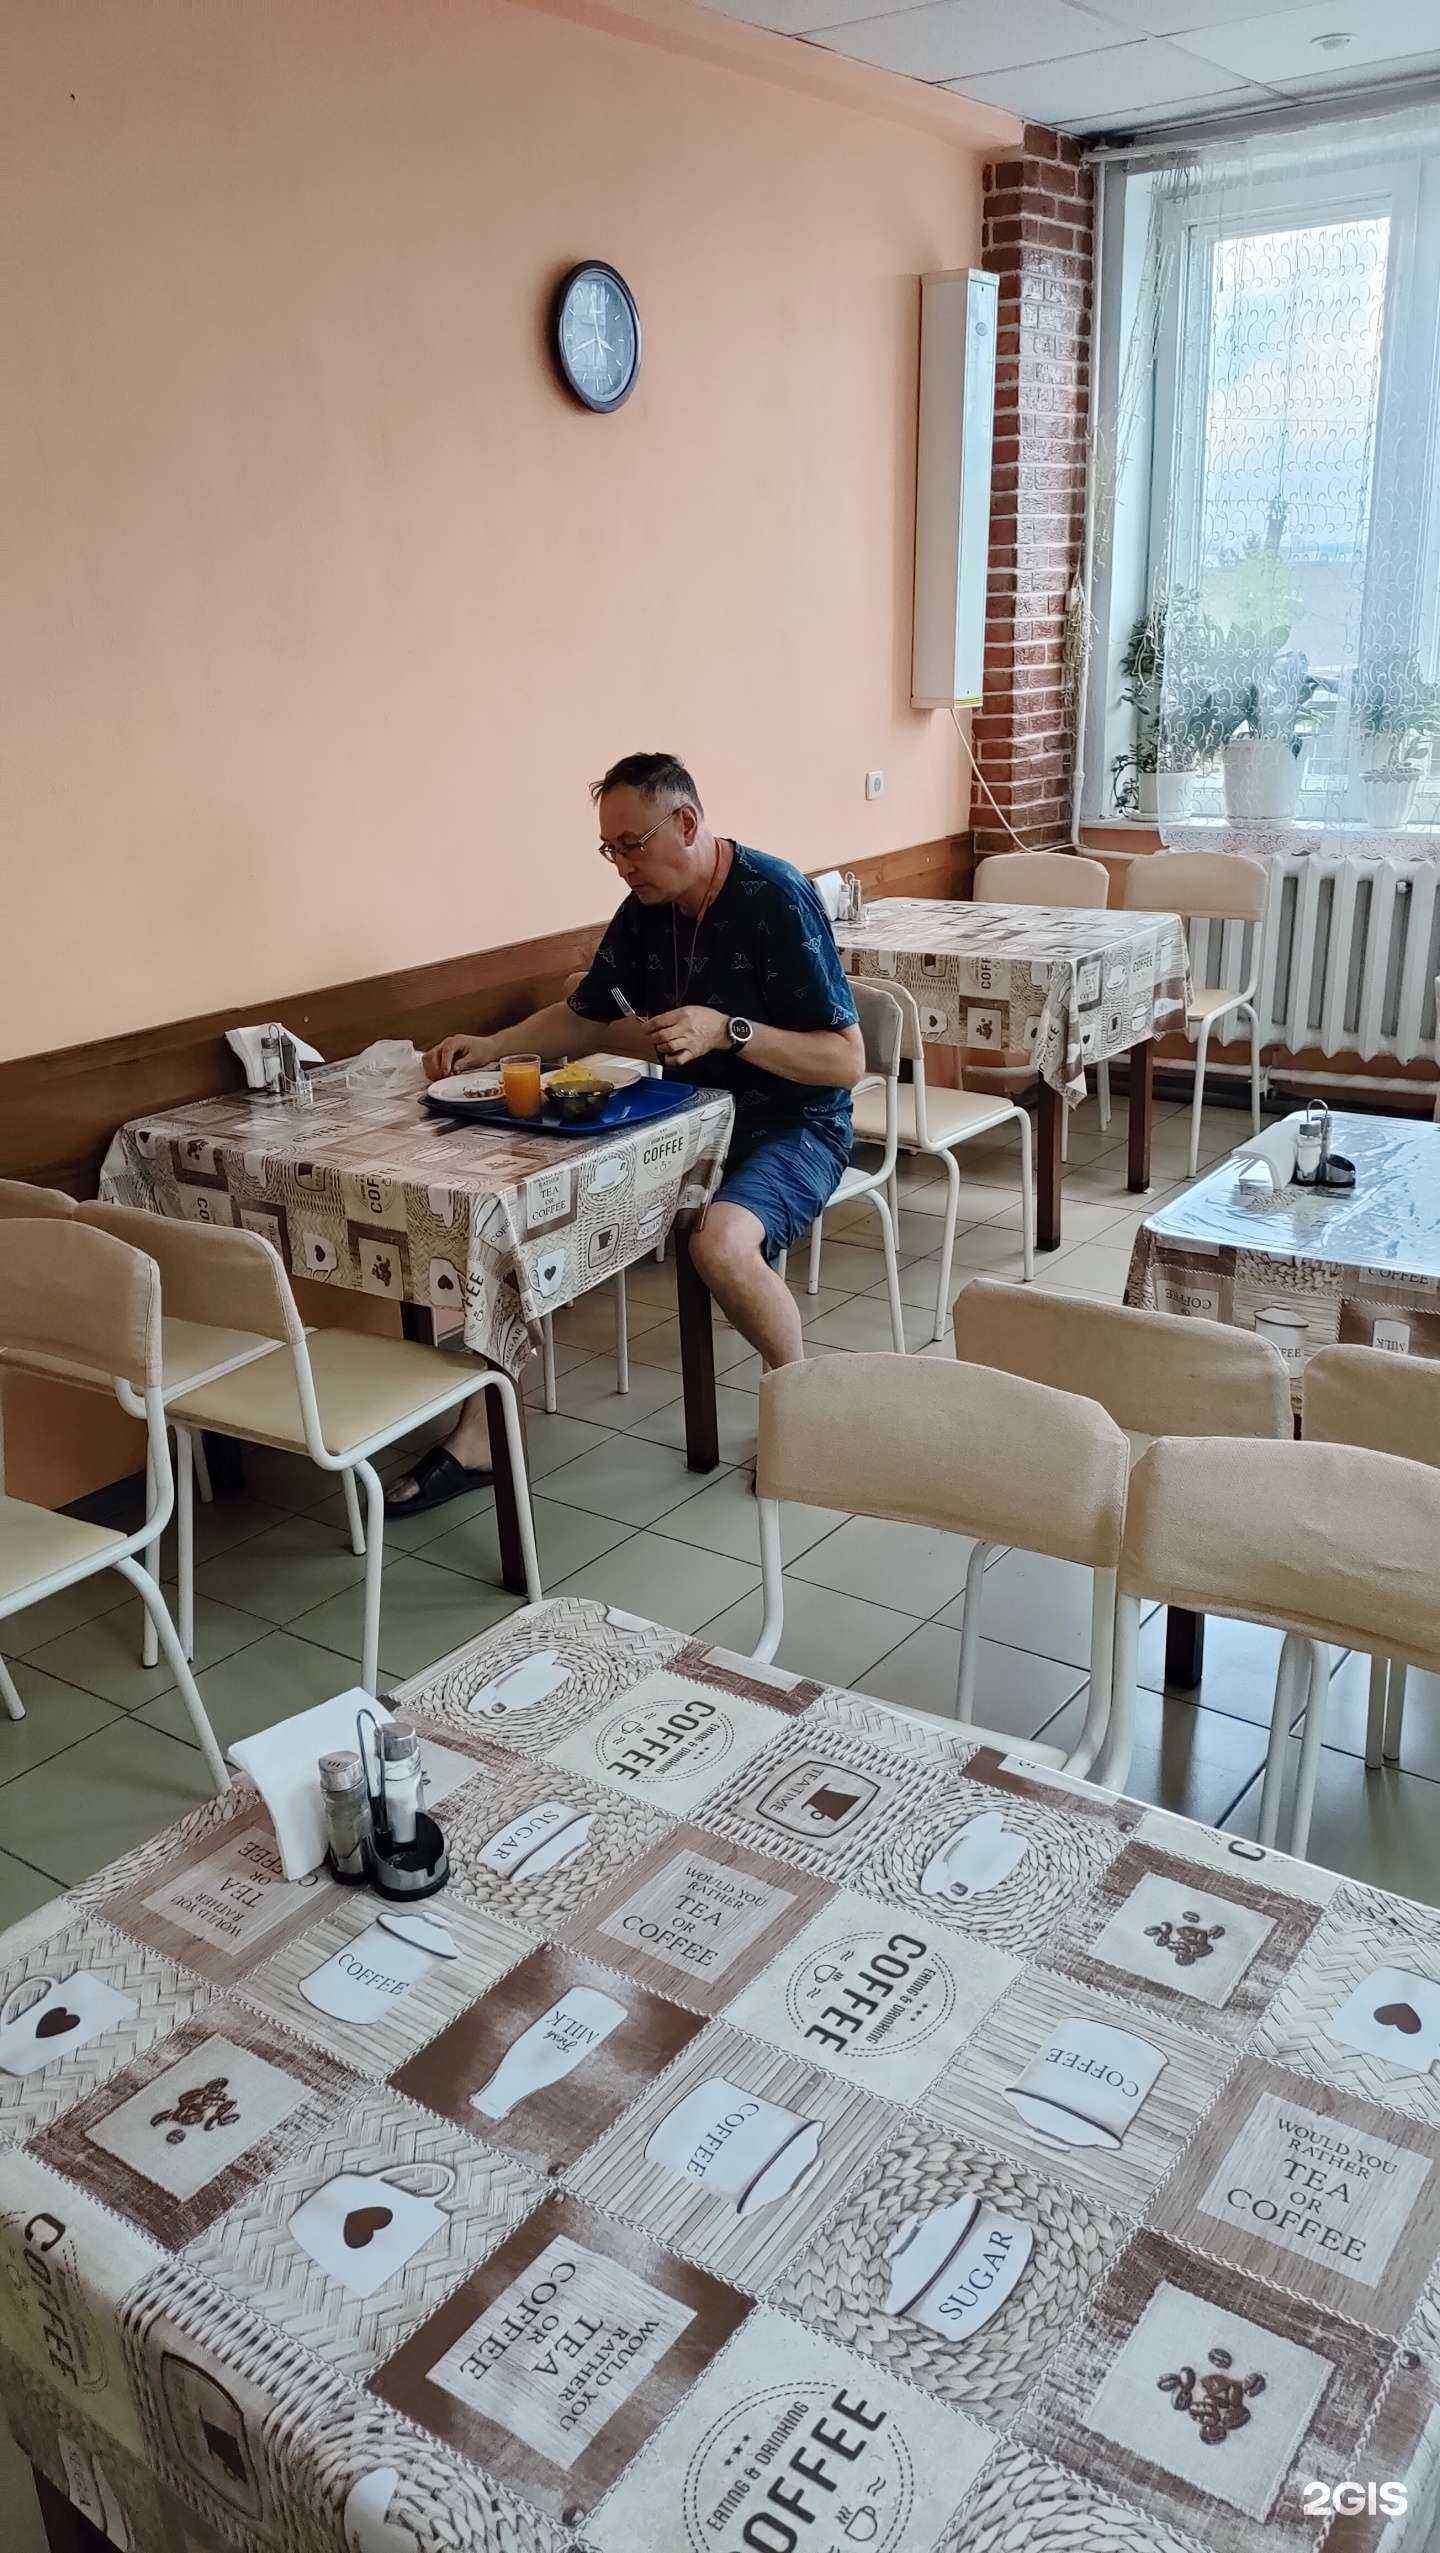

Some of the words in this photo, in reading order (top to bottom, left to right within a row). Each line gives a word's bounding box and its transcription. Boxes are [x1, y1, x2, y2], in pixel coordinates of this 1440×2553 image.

[643, 1136, 685, 1165] COFFEE
[532, 1200, 567, 1222] COFFEE
[540, 1185, 560, 1199] TEA
[1165, 1288, 1212, 1310] COFFEE
[606, 1701, 716, 1780] COFFEE
[492, 1809, 560, 1860] SUGAR
[219, 1876, 265, 1908] TEA
[249, 1870, 272, 1886] OR
[686, 1866, 735, 1893] WOULD
[738, 1890, 769, 1907] YOU
[687, 1881, 745, 1910] RATHER
[170, 1894, 196, 1914] YOU
[195, 1892, 246, 1923] RATHER
[198, 1911, 243, 1938] WOULD
[672, 1916, 696, 1934] OR
[675, 1894, 723, 1927] TEA
[622, 1915, 719, 1966] COFFEE
[338, 1953, 410, 1995] COFFEE
[804, 1933, 927, 2053] COFFEE
[906, 1967, 937, 1996] EATING
[547, 2010, 600, 2044] MILK
[865, 2003, 906, 2045] DRINKING
[1045, 2047, 1139, 2098] COFFEE
[686, 2102, 760, 2177] COFFEE
[1278, 2117, 1350, 2156] WOULD
[1357, 2148, 1398, 2175] YOU
[1287, 2137, 1371, 2180] RATHER
[1283, 2157, 1350, 2204] TEA
[1289, 2190, 1323, 2214] OR
[1227, 2188, 1367, 2262] COFFEE
[938, 2230, 1014, 2320] SUGAR
[459, 2262, 576, 2381] COFFEE
[527, 2315, 560, 2345] OR
[532, 2314, 604, 2376] TEA
[558, 2326, 630, 2401] RATHER
[595, 2319, 660, 2387] WOULD
[559, 2389, 599, 2432] YOU
[706, 2478, 751, 2532] EATING
[754, 2400, 810, 2466] DRINKING
[730, 2388, 888, 2553] OFFEE
